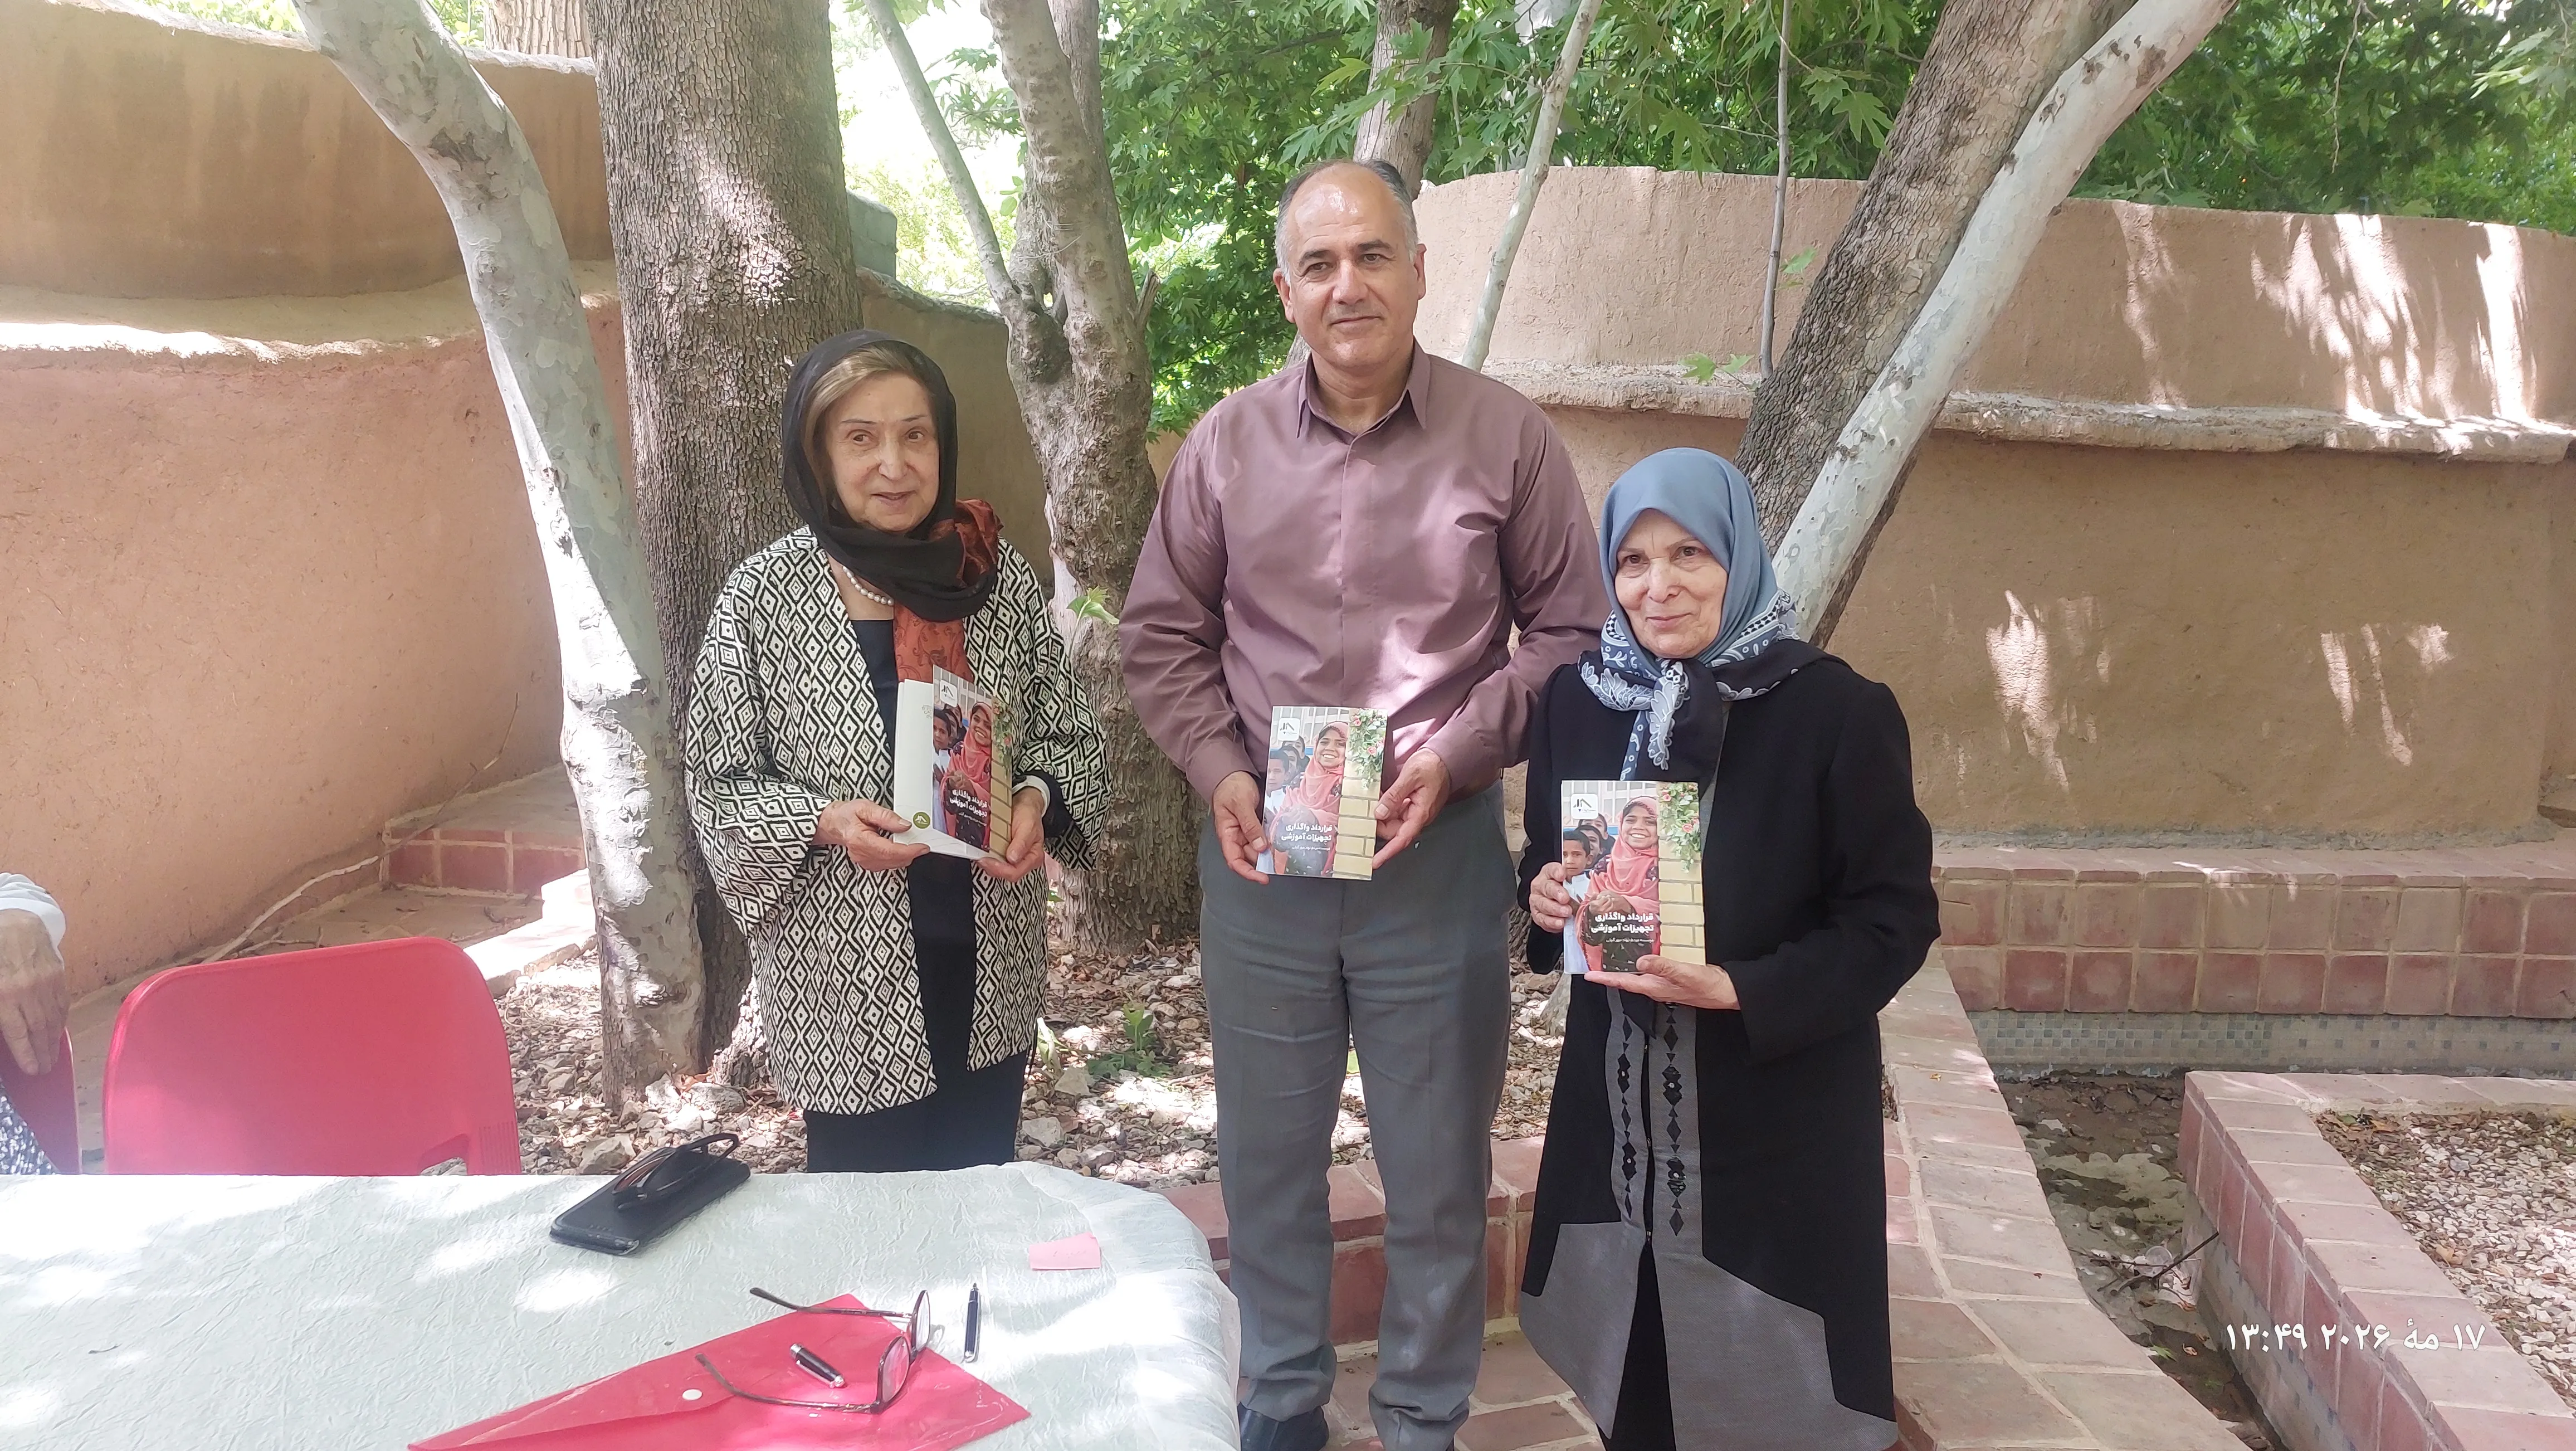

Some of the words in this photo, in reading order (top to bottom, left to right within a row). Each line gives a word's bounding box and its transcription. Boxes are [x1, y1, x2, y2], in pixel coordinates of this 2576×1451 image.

[952, 789, 971, 802] واگذاری
[949, 797, 968, 809] آموزشی
[972, 797, 987, 808] قرارداد
[1285, 822, 1310, 831] واگذاری
[1310, 824, 1333, 832] قرارداد
[1281, 832, 1306, 841] آموزشی
[1594, 912, 1626, 922] واگذاری
[1627, 913, 1654, 922] قرارداد
[1591, 923, 1622, 933] آموزشی
[1622, 924, 1655, 933] تجهیزات
